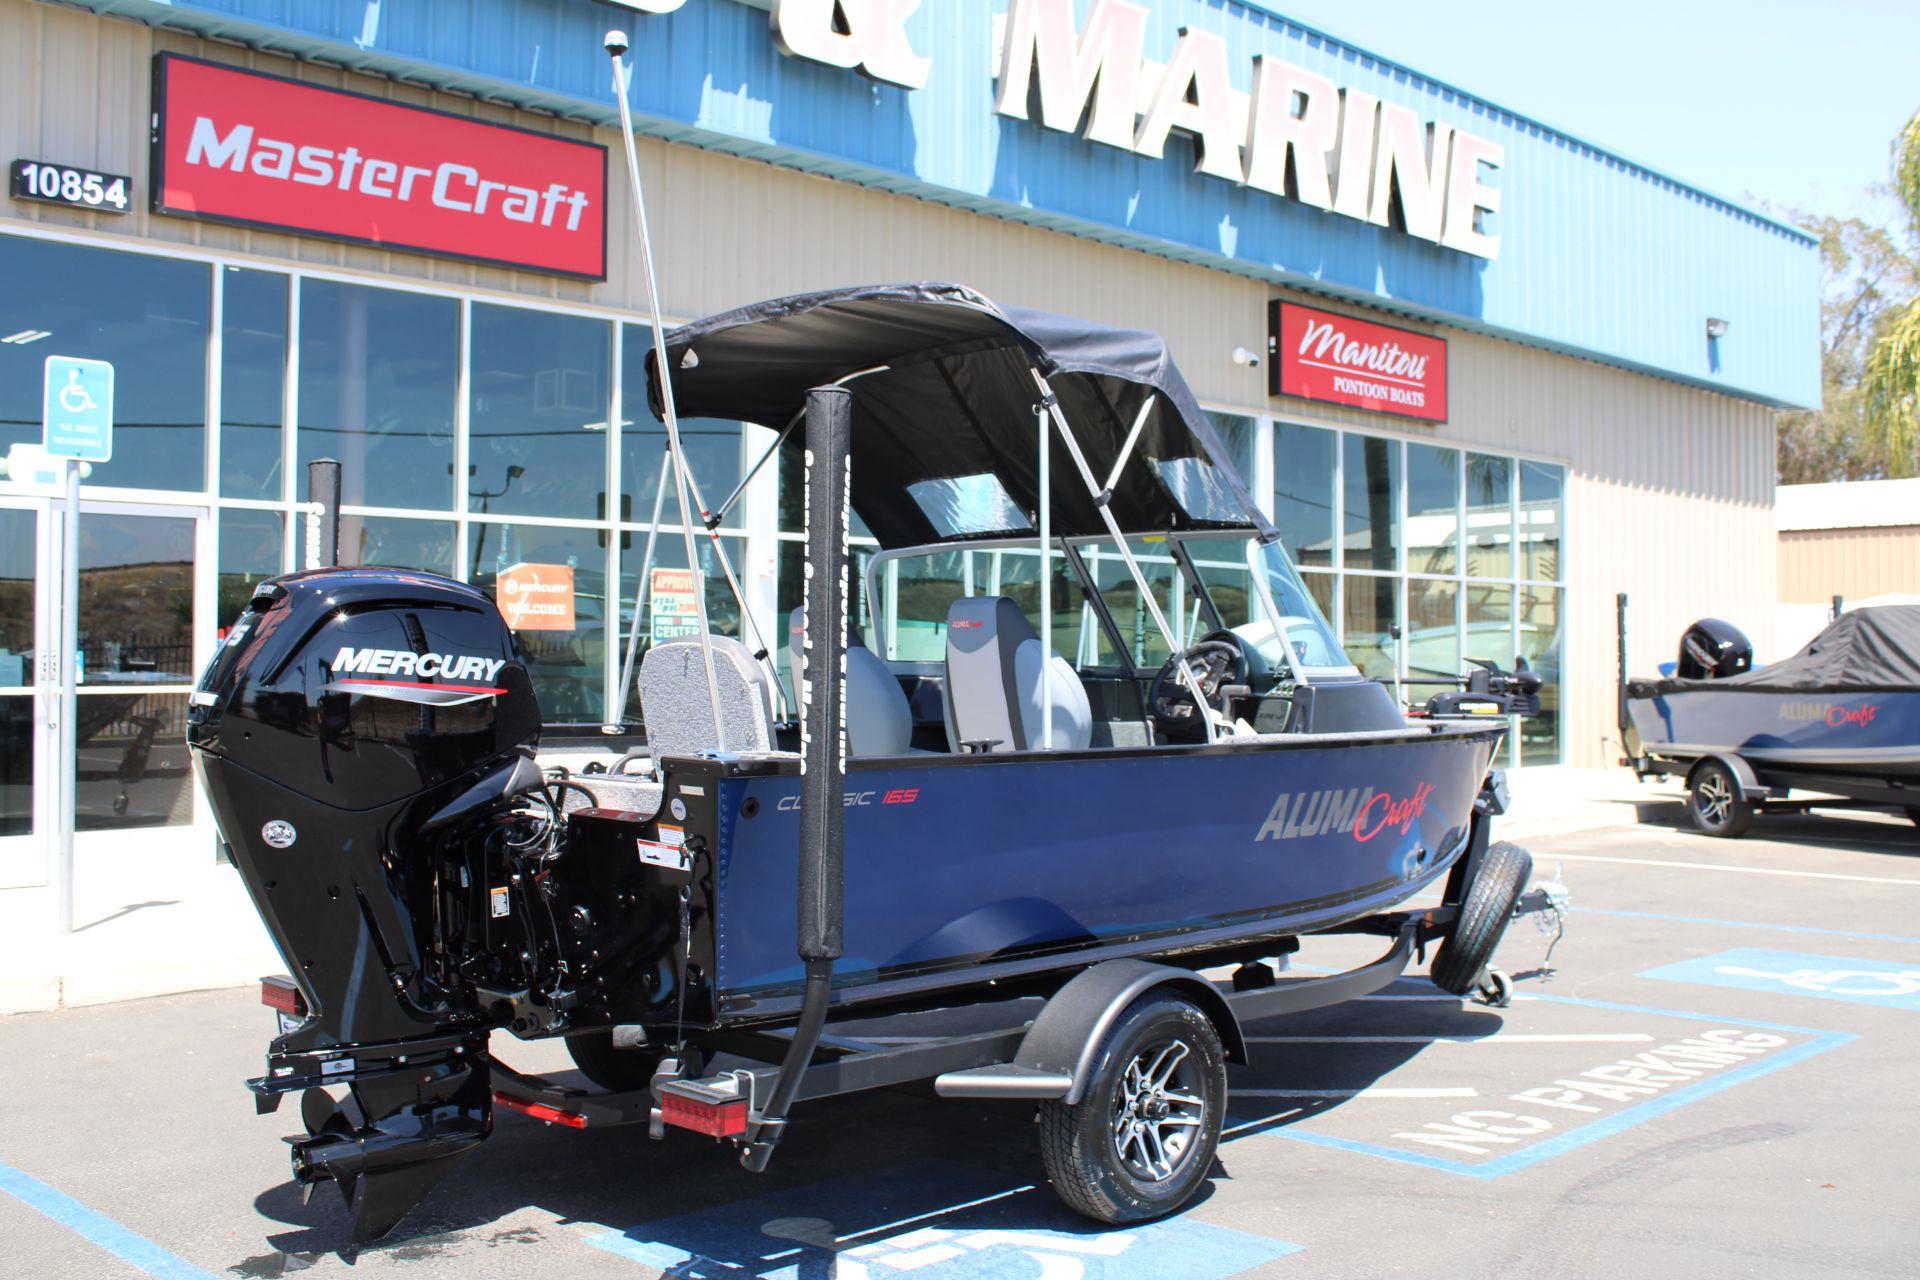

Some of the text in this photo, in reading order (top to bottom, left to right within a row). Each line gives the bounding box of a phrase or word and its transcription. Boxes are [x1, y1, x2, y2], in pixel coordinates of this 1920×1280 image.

[993, 0, 1505, 260] MARINE
[22, 163, 128, 209] 10854
[185, 116, 589, 231] MasterCraft
[1298, 319, 1426, 380] Manitou
[1333, 376, 1425, 407] PONTOON BOATS
[507, 602, 566, 615] WELCOME
[331, 647, 506, 682] MERCURY
[777, 788, 920, 811] CLSIC 165
[1391, 1029, 1788, 1154] NO PARKING
